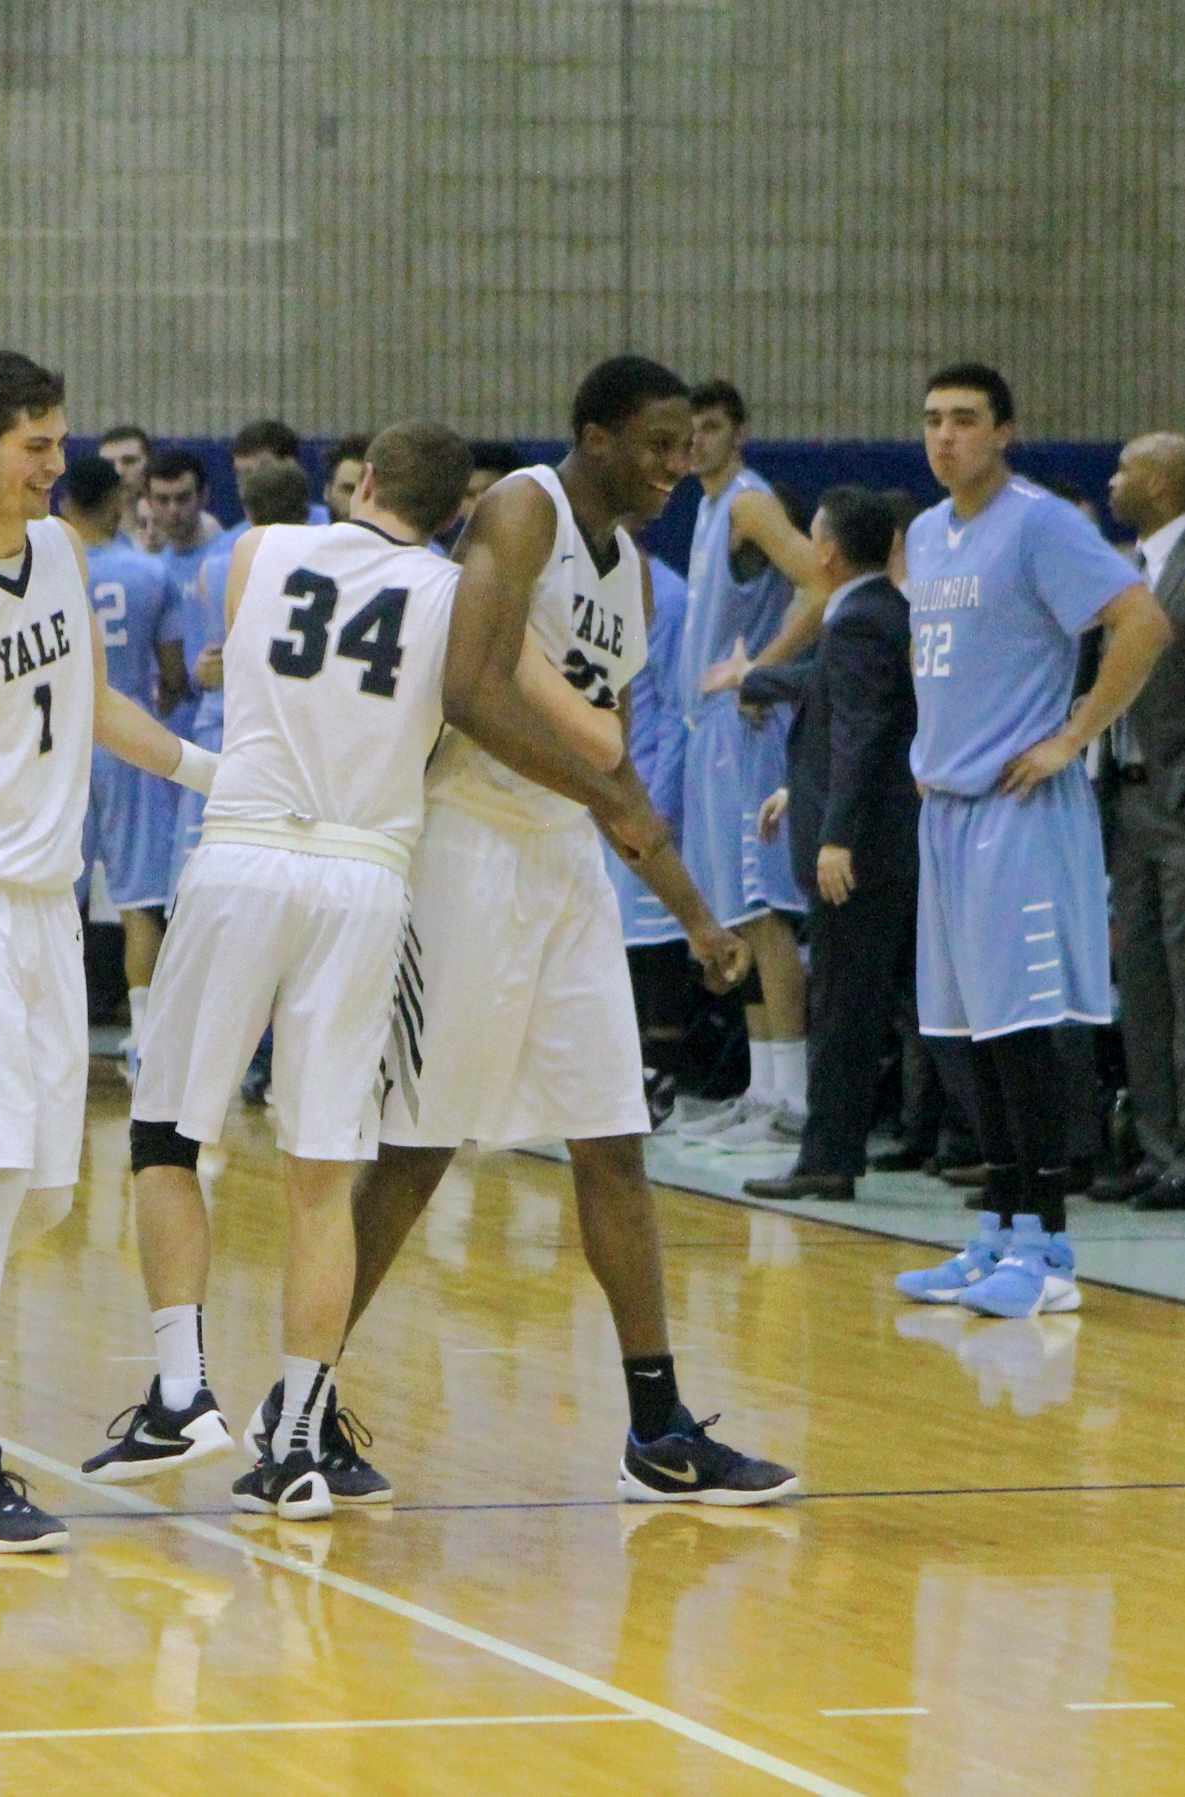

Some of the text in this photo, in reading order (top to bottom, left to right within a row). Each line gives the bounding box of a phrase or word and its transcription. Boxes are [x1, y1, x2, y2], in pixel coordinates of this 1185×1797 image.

[269, 567, 409, 697] 34
[916, 622, 952, 678] 32
[33, 684, 53, 755] 1
